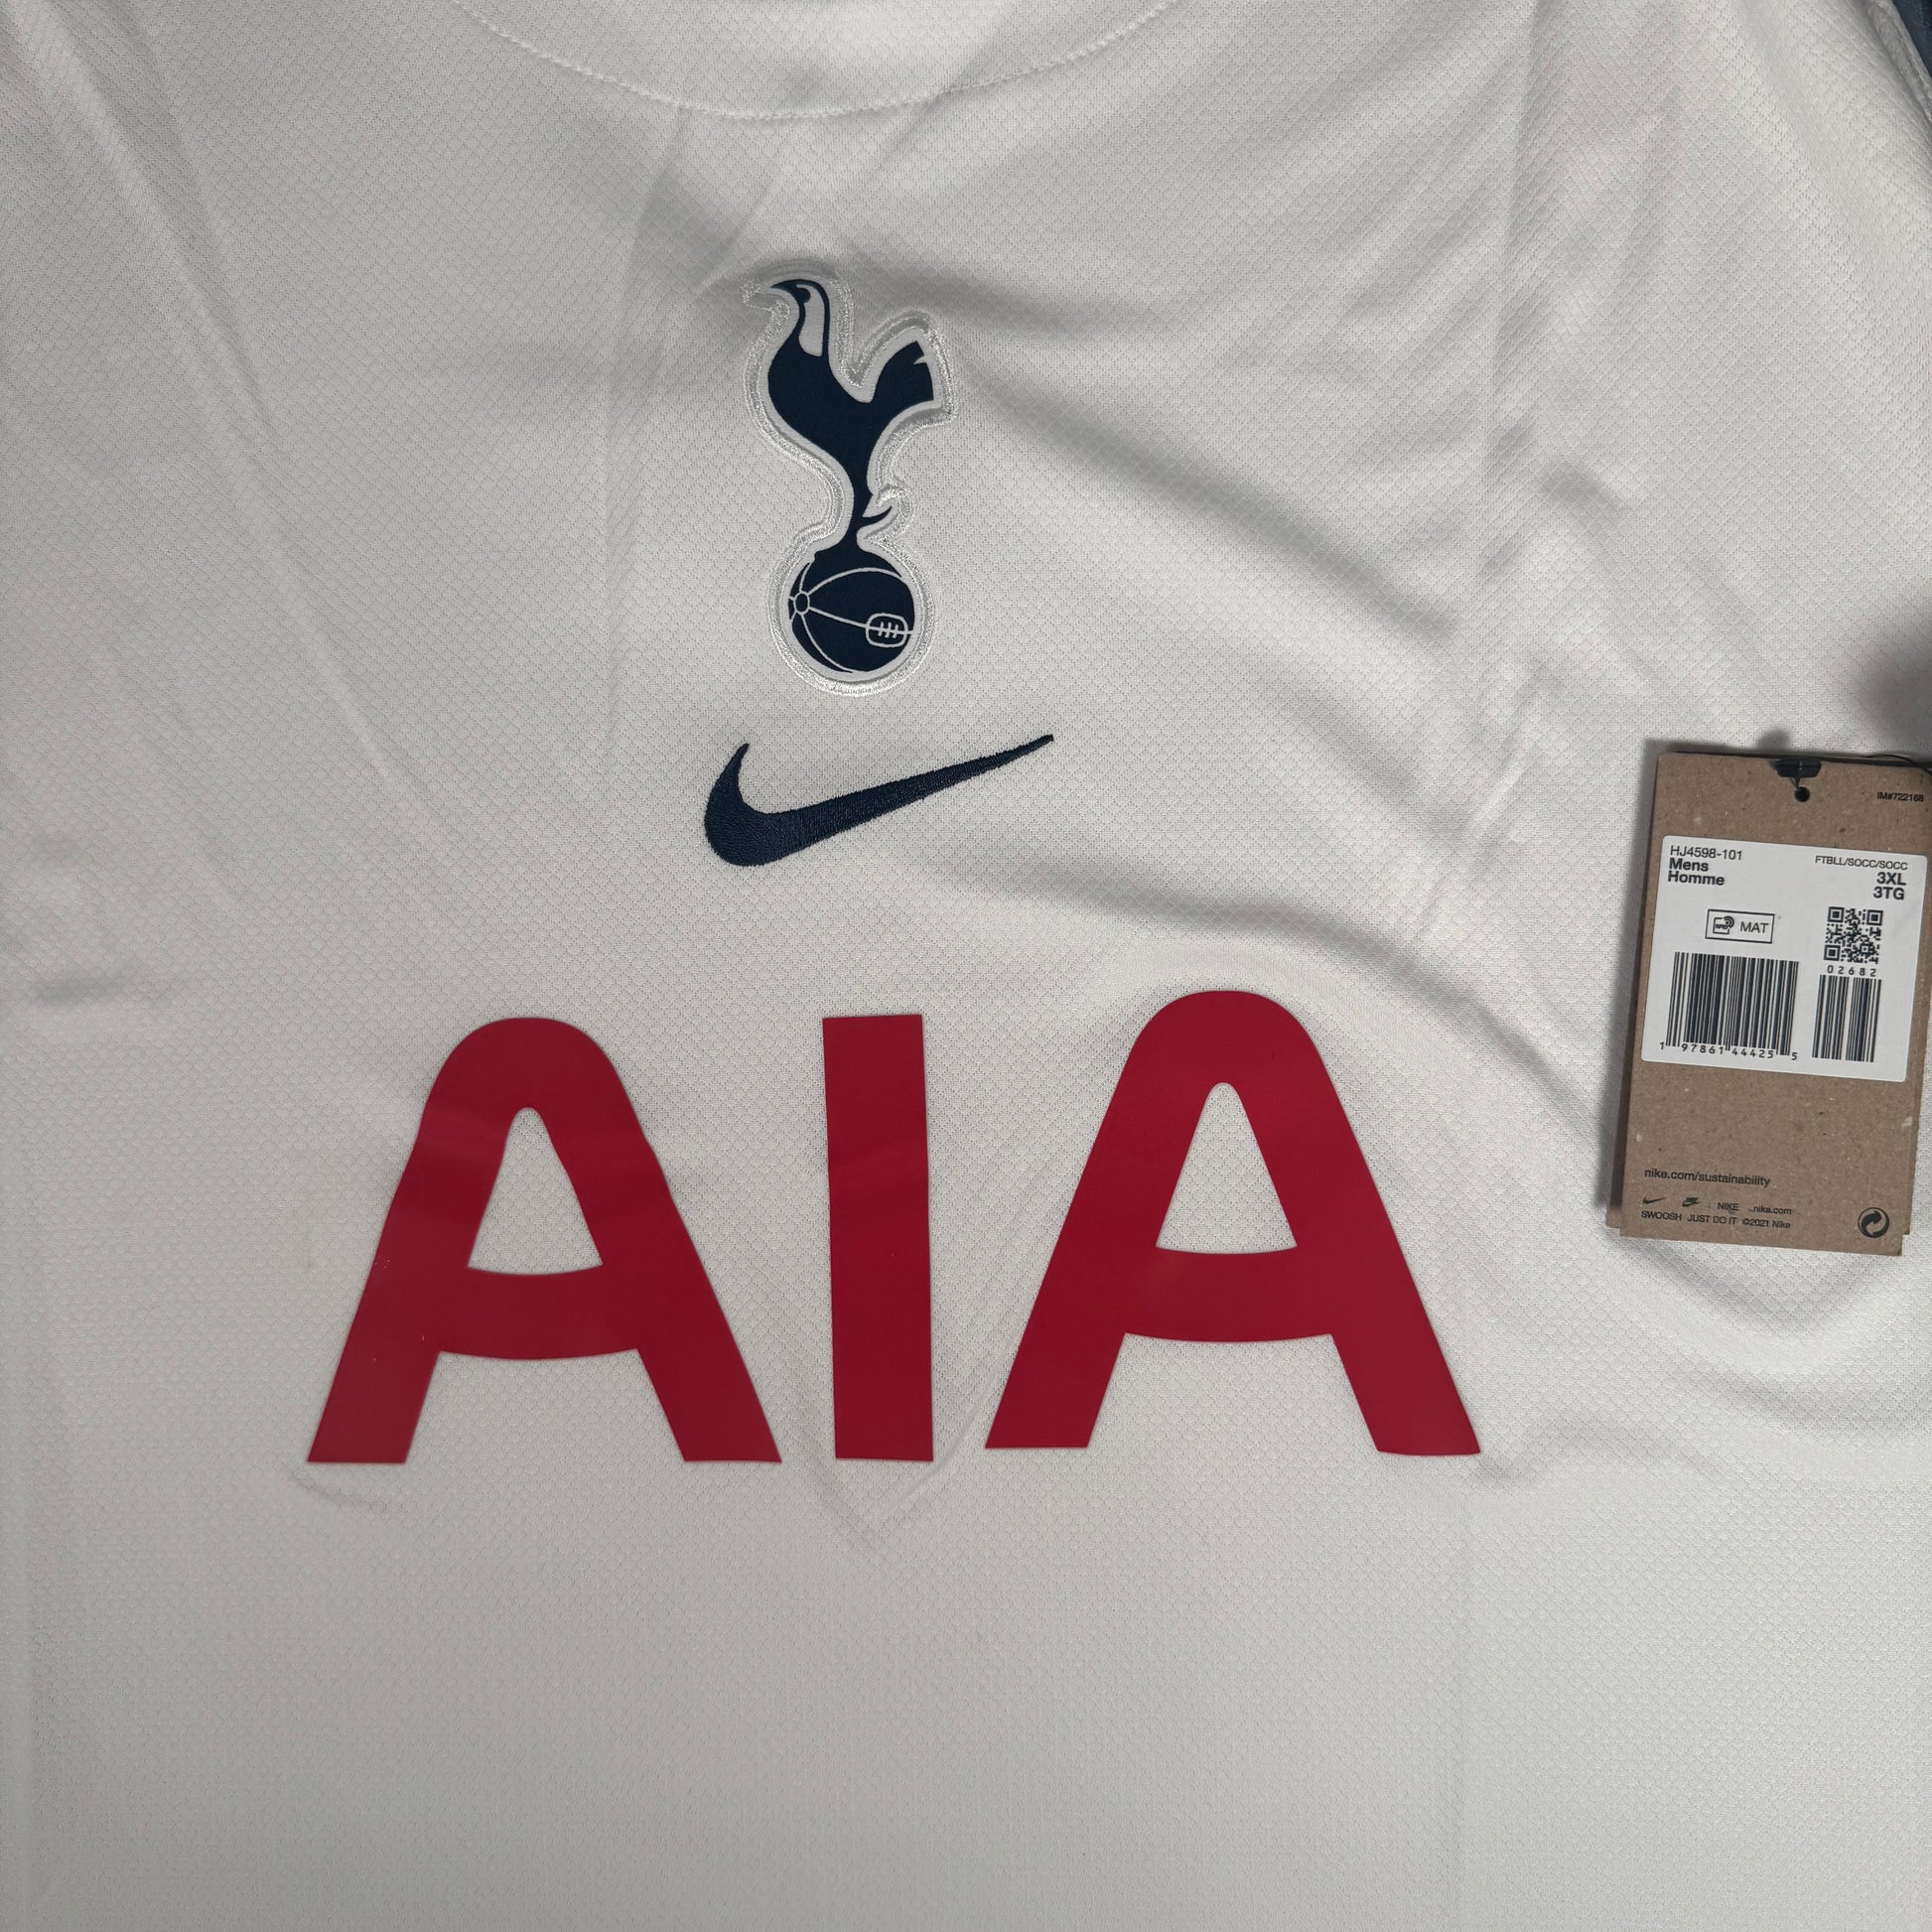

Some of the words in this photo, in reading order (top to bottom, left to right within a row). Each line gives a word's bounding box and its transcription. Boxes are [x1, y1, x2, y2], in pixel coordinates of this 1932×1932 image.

[1670, 845, 1742, 861] HJ4598-101
[1668, 857, 1709, 872] Mens
[1815, 855, 1908, 870] FTBLL/SOCC/SOCC
[1667, 870, 1725, 886] Homme
[1876, 872, 1906, 886] 3XL
[1872, 886, 1905, 900] 3TG
[1739, 920, 1769, 934] MAT
[1827, 964, 1876, 977] 02682
[1644, 1168, 1770, 1188] nike.com/sustainability
[1717, 1201, 1739, 1211] NIKE
[309, 991, 1479, 1463] AIA
[1641, 1210, 1683, 1221] SWOOSH
[1687, 1213, 1711, 1223] JUST
[1713, 1215, 1727, 1224] DO
[1728, 1216, 1738, 1225] IT
[1772, 1220, 1791, 1229] Nike
